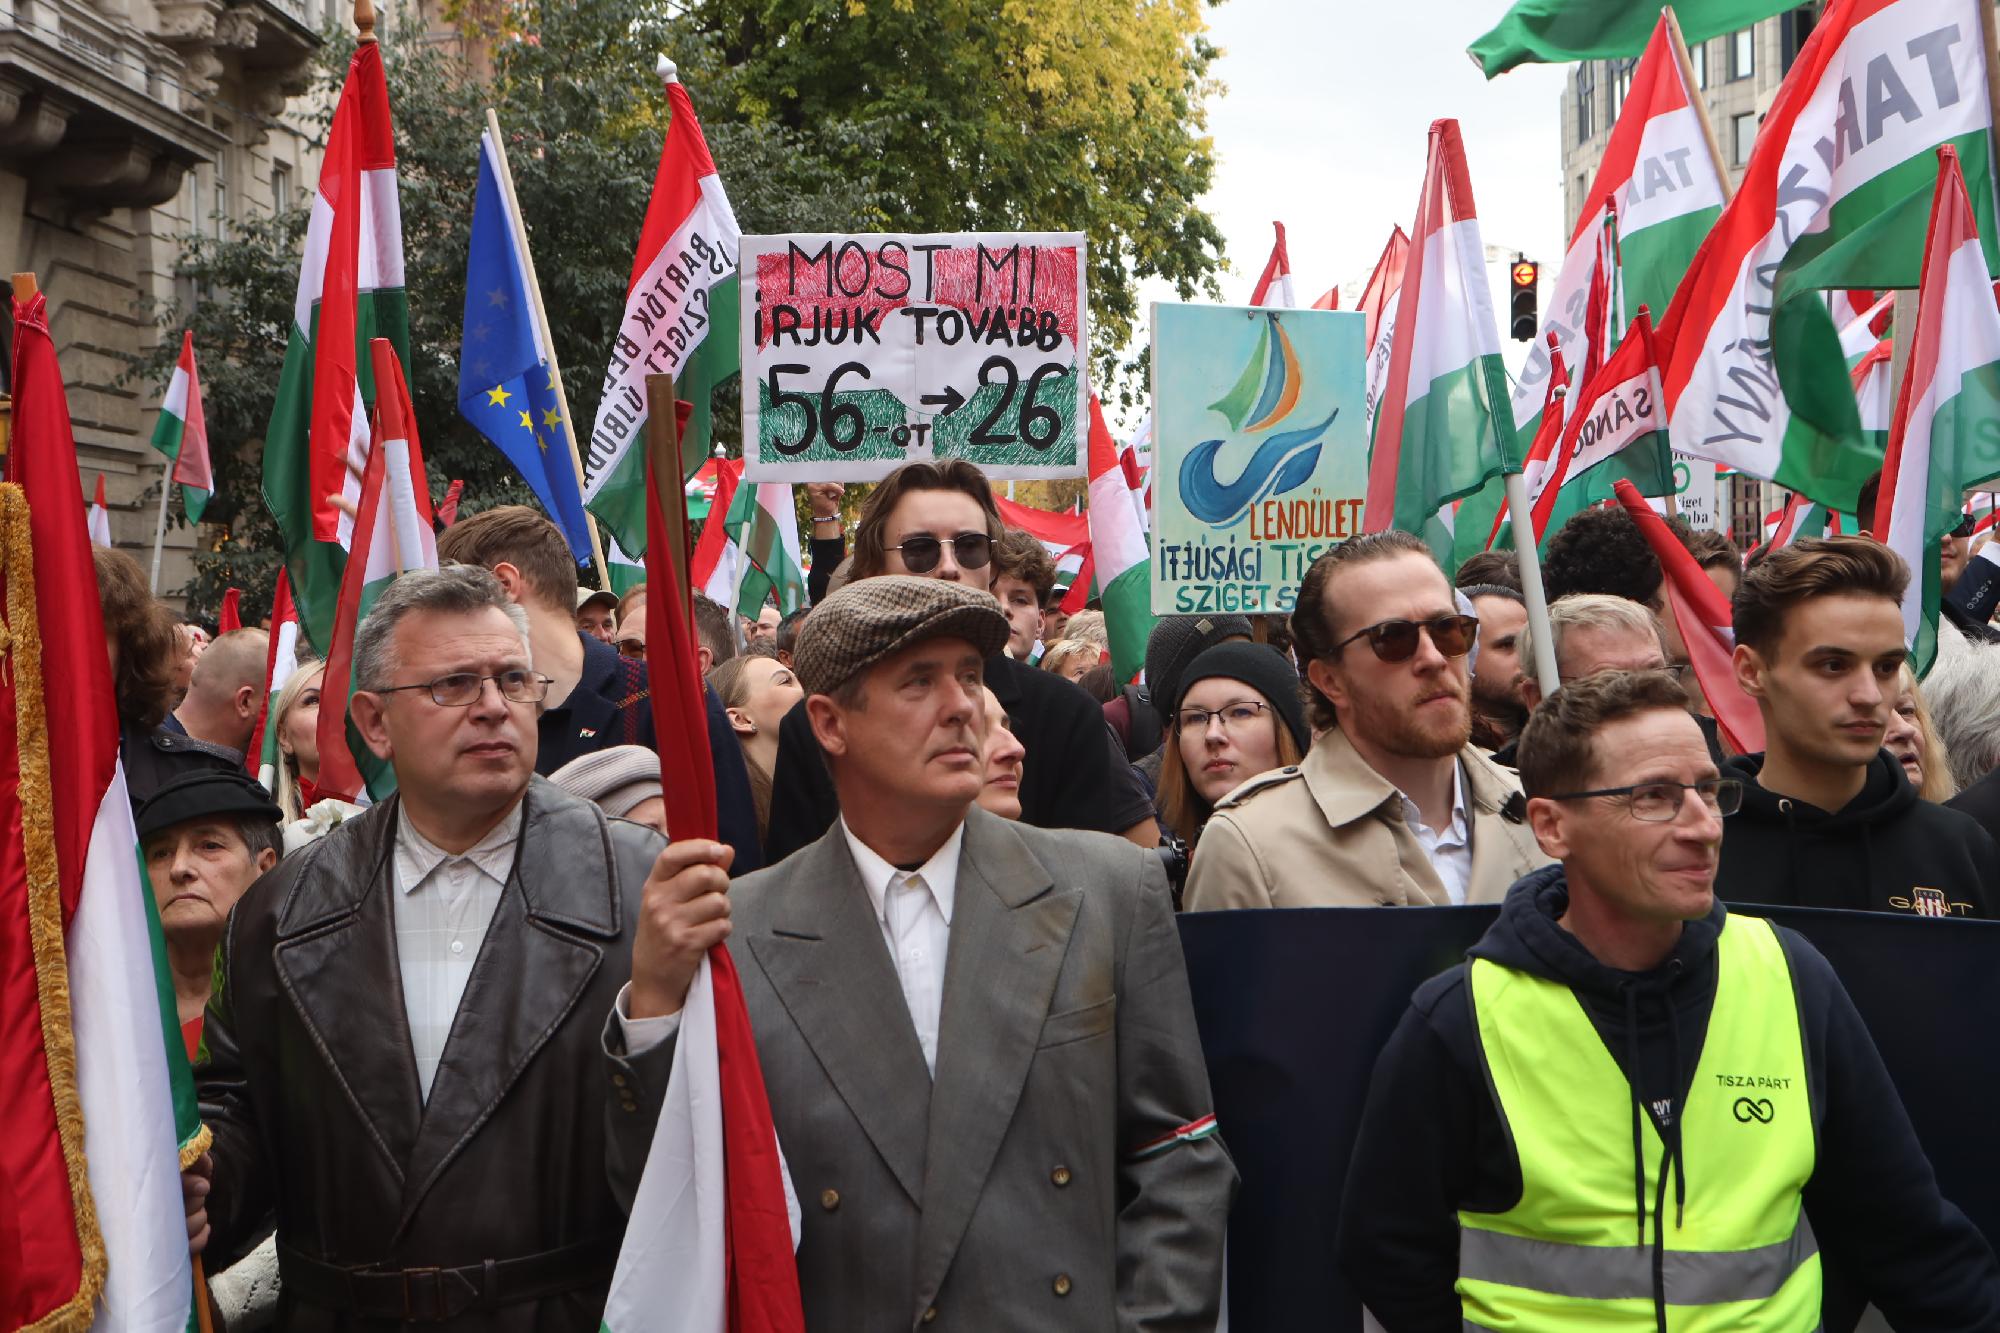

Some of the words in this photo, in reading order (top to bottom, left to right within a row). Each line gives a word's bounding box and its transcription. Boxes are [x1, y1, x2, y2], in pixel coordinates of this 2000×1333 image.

[788, 240, 952, 301] MOST
[977, 242, 1036, 304] MI
[900, 306, 1063, 352] TOVÁBB
[968, 355, 1069, 451] 26
[1250, 488, 1364, 541] LENDÜLET
[1679, 496, 1702, 509] iget
[1888, 896, 1974, 916] GANT
[1716, 1075, 1755, 1088] TISZA
[1758, 1075, 1792, 1090] PÁRT
